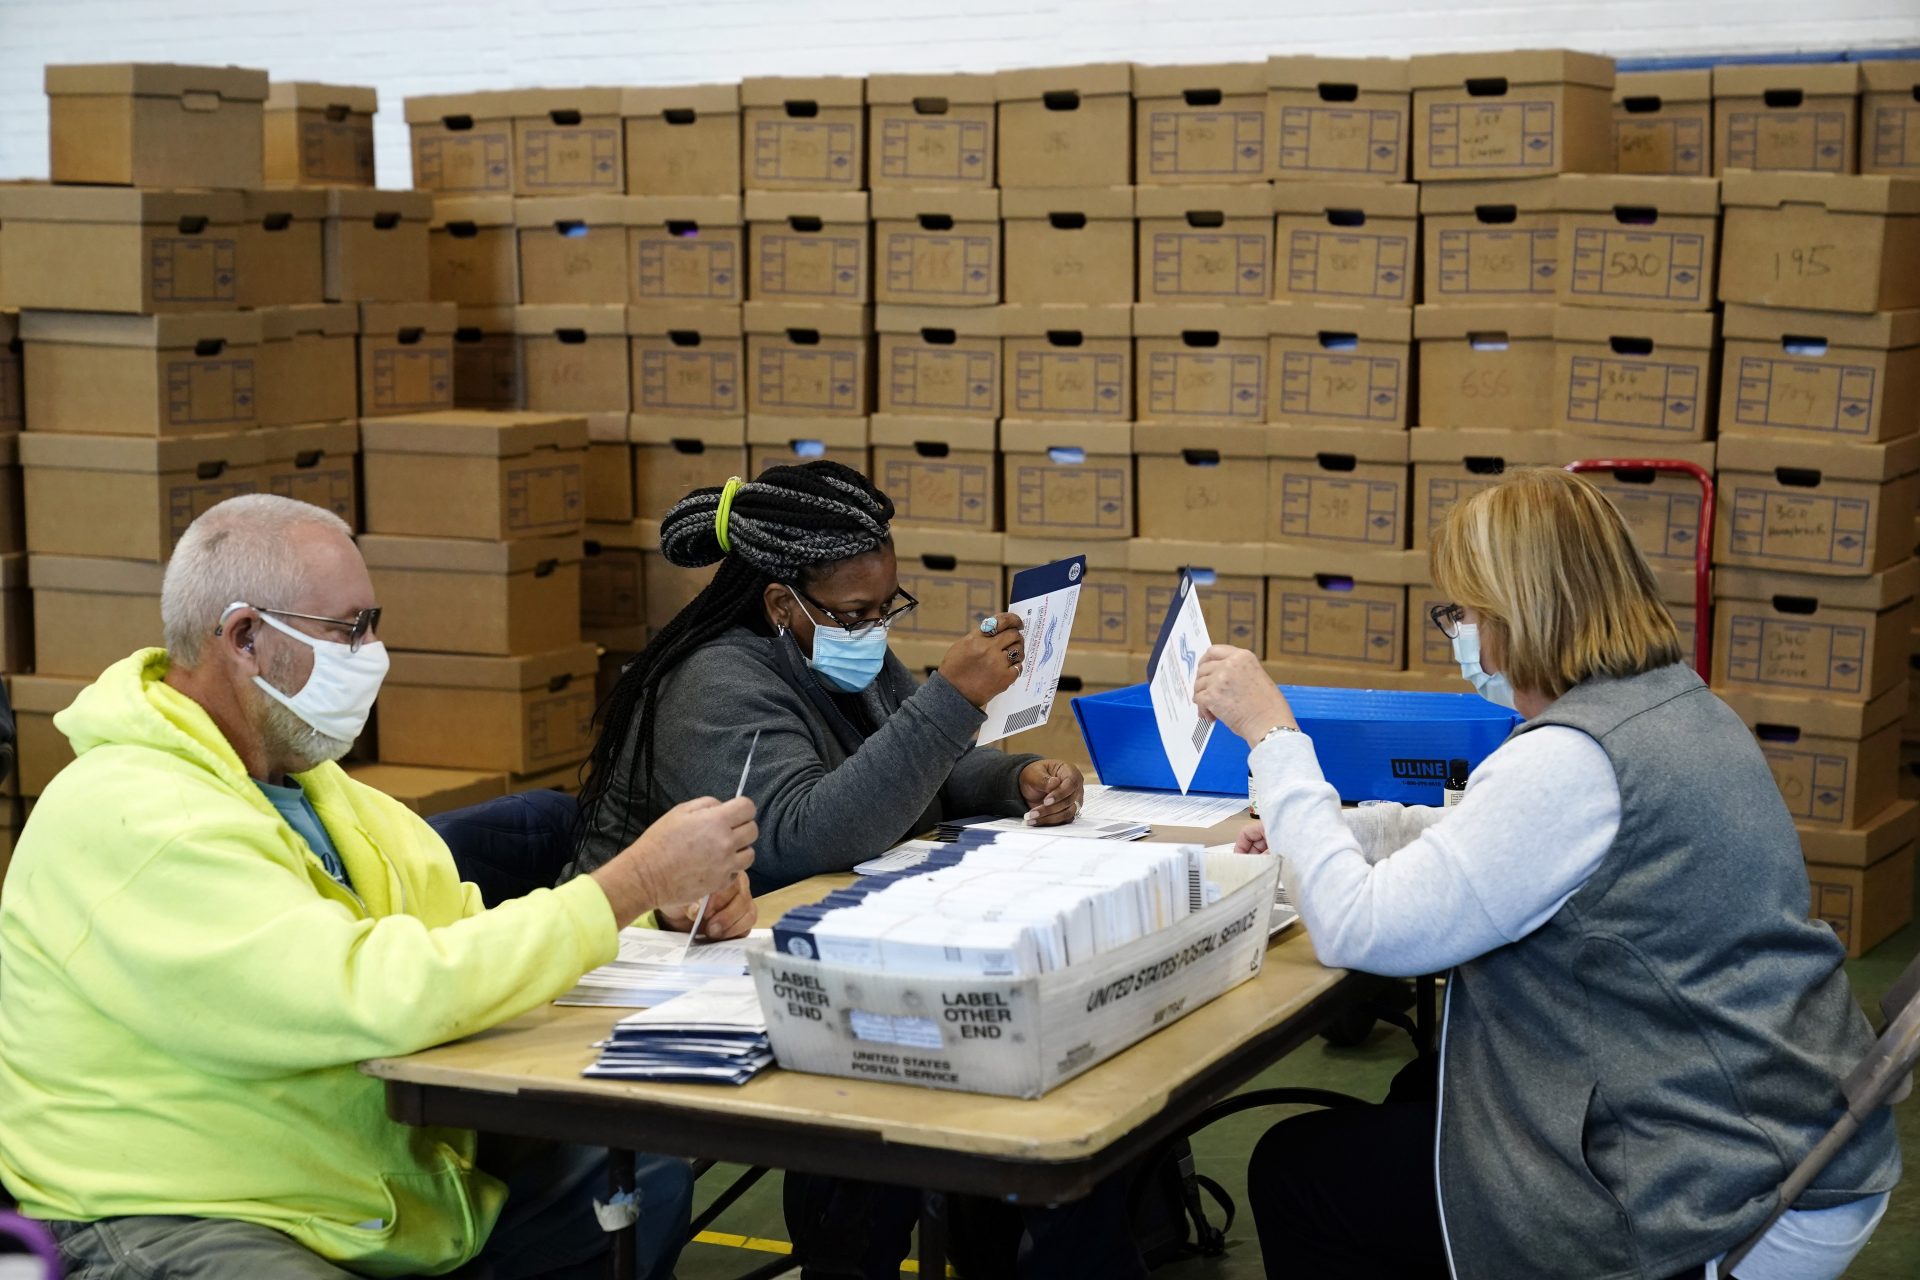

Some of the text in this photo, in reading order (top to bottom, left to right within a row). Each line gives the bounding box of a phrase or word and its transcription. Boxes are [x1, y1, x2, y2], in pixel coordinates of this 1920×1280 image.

[1607, 251, 1662, 278] 520
[1775, 243, 1835, 280] 195
[1461, 367, 1511, 399] 656
[1395, 762, 1444, 777] ULINE
[1086, 907, 1258, 1013] UNITED STATES POSTAL SERVICE
[771, 968, 827, 993] LABEL
[773, 984, 830, 1007] OTHER
[942, 992, 1009, 1007] LABEL
[787, 1002, 823, 1022] END
[944, 1008, 1012, 1023] OTHER
[960, 1024, 1002, 1039] END
[853, 1050, 951, 1071] UNITED STATES
[852, 1061, 959, 1082] POSTAL SERVICE
